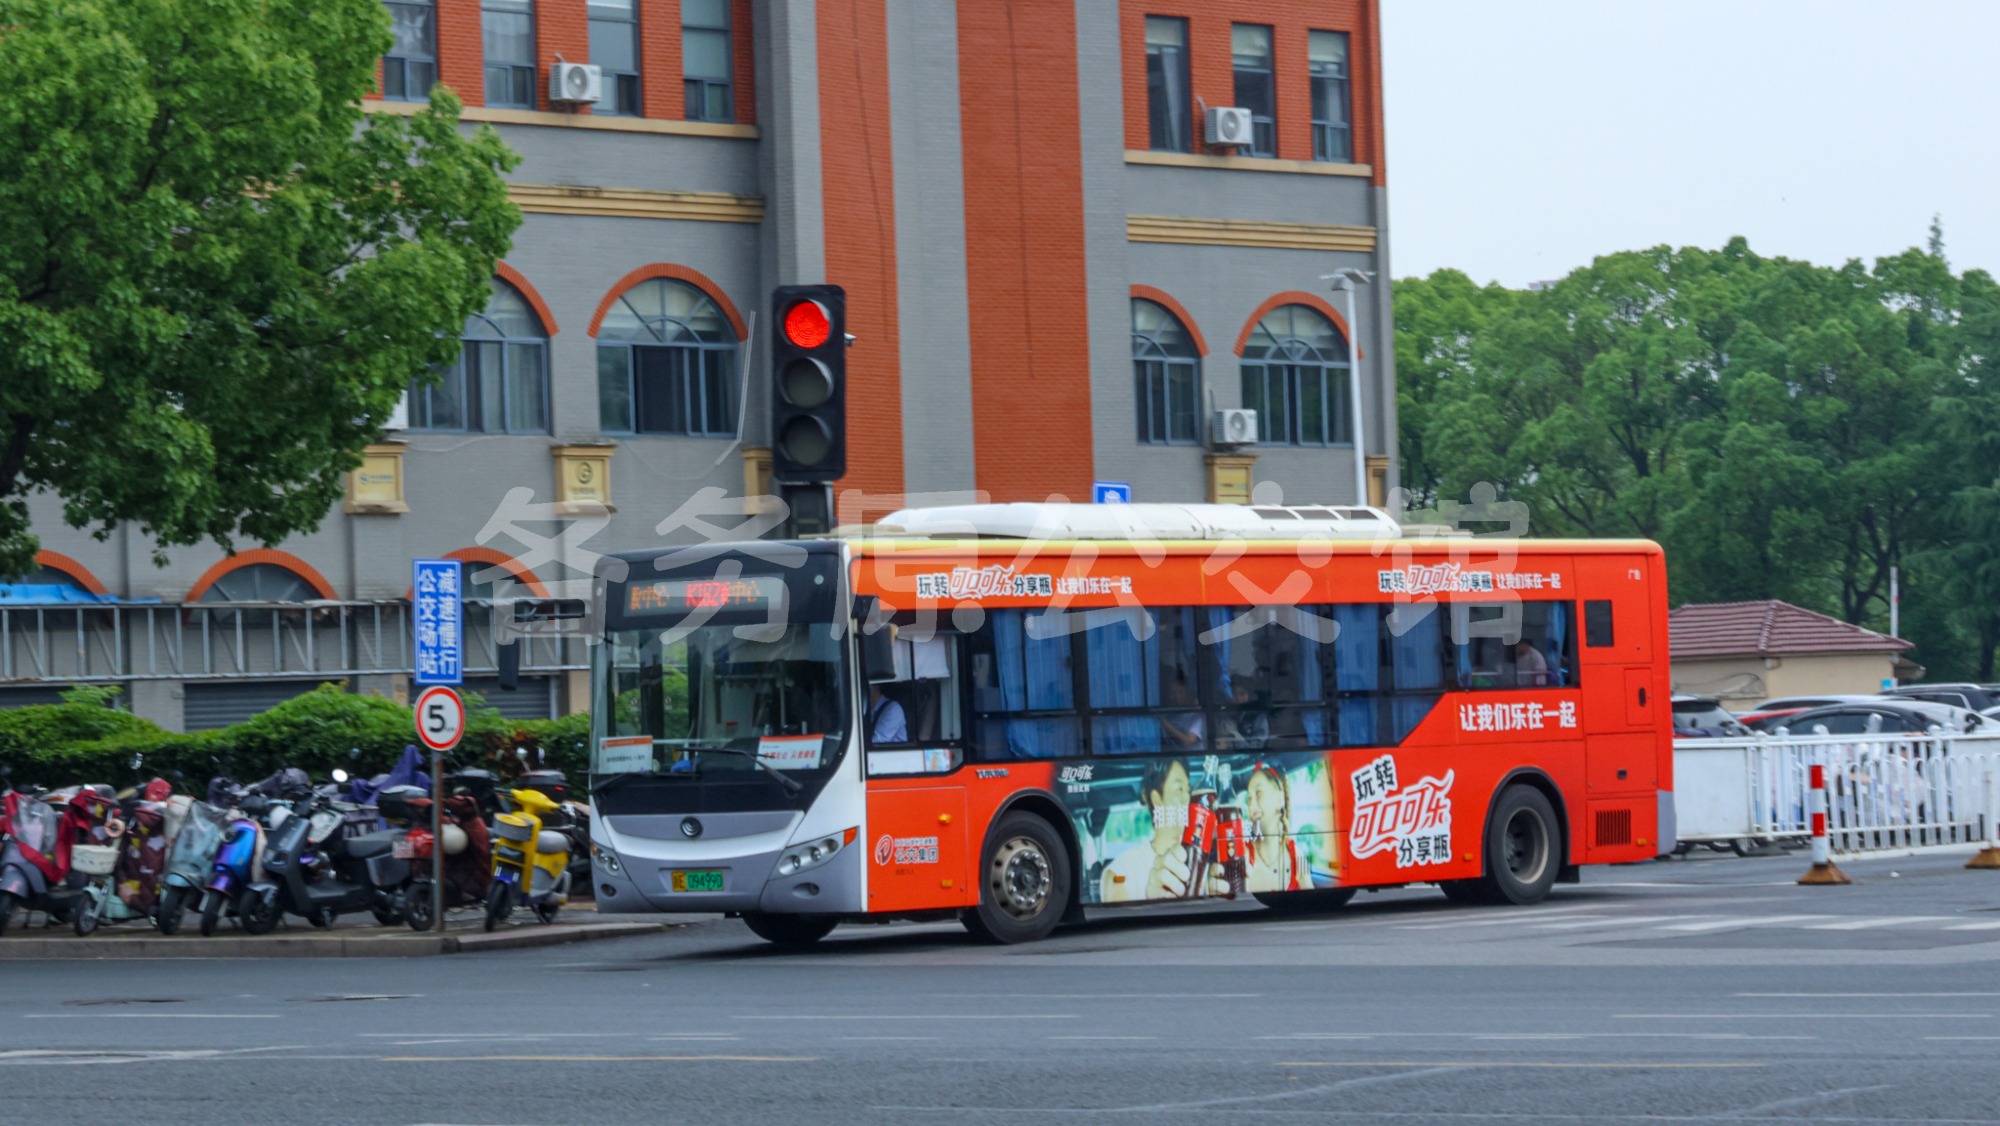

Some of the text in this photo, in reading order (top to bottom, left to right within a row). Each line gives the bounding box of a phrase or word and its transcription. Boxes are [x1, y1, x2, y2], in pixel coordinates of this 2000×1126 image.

[1056, 577, 1133, 595] 让我们乐在一起
[1497, 573, 1561, 589] 让我们乐在一起
[419, 568, 438, 675] 公交场站
[438, 568, 457, 675] 减速慢行
[429, 705, 445, 733] 5
[1459, 701, 1577, 731] 让我们乐在一起
[1354, 760, 1395, 801] 玩转
[1353, 777, 1451, 854] 可口可乐
[896, 847, 938, 863] 公交集团
[1400, 834, 1449, 864] 分享瓶
